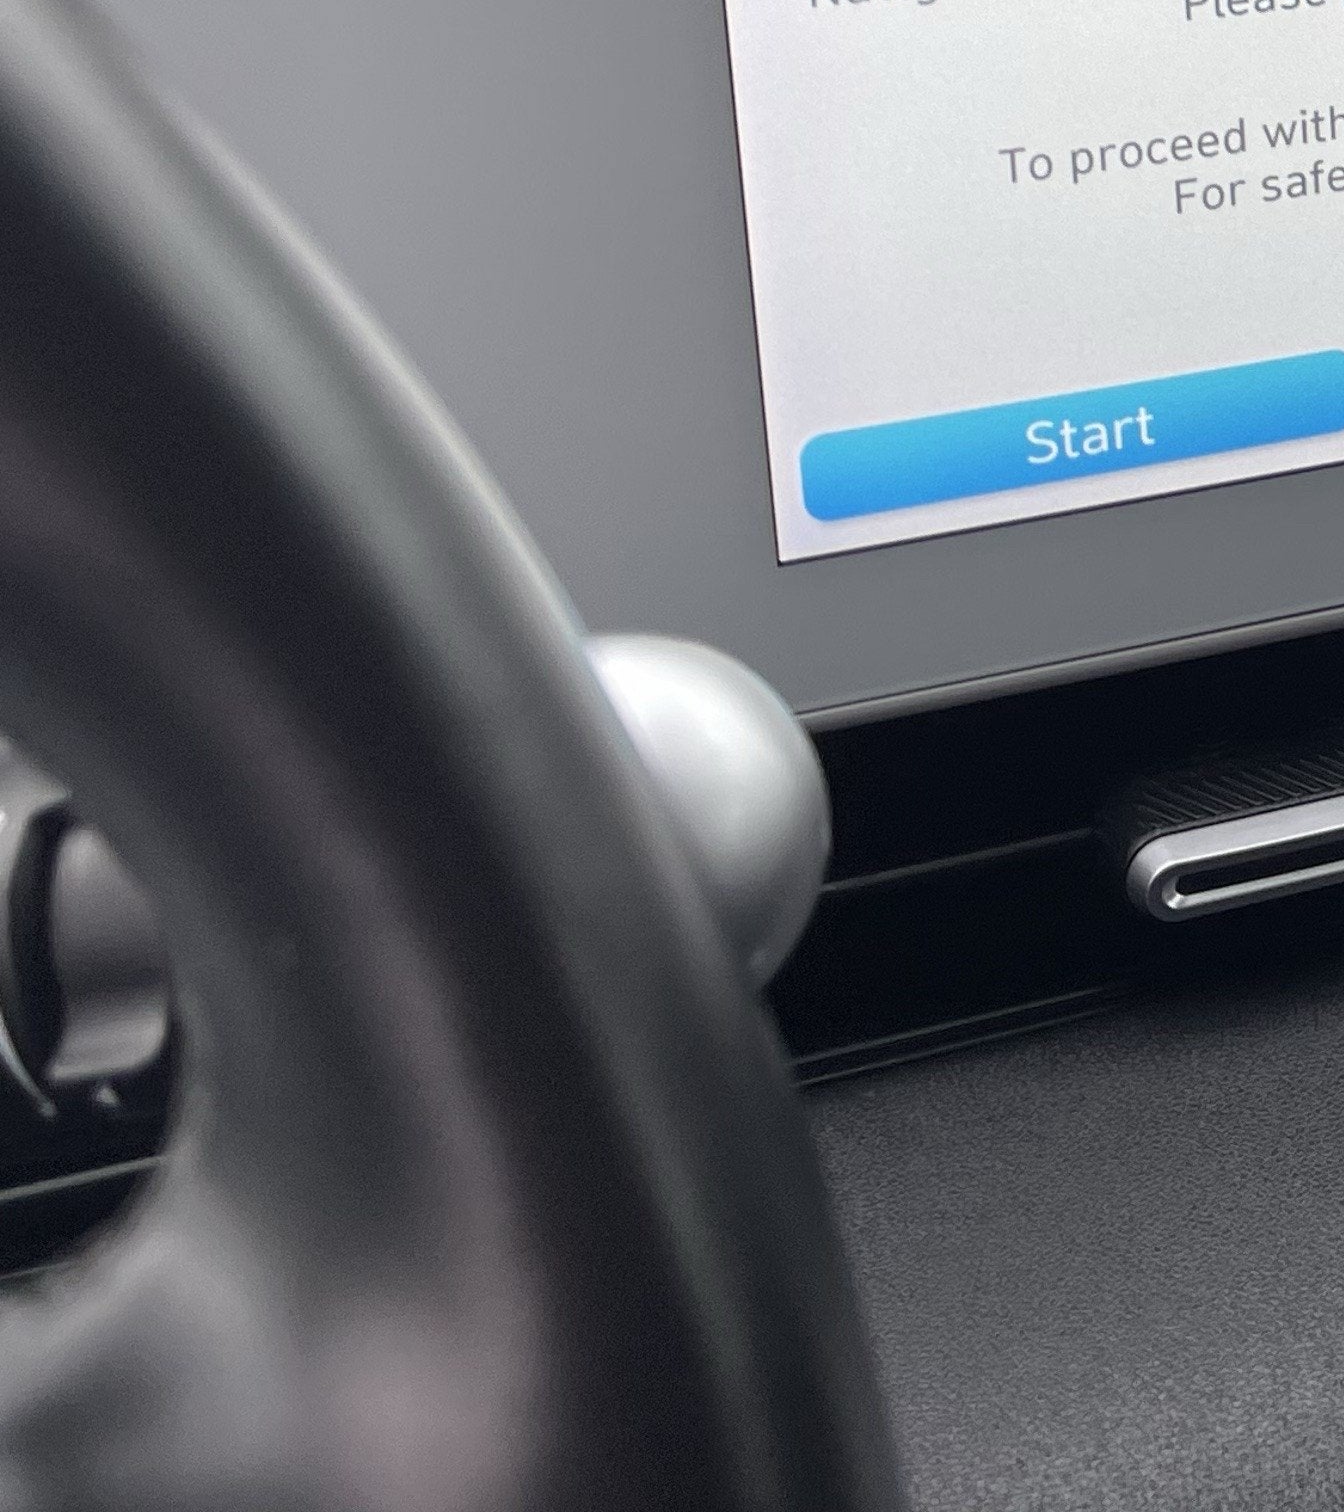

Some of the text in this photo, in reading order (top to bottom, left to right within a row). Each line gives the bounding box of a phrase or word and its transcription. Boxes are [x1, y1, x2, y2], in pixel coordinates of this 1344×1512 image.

[998, 146, 1054, 184] To
[1070, 117, 1247, 185] proceed
[1174, 177, 1246, 215] For
[1028, 412, 1154, 464] Start
